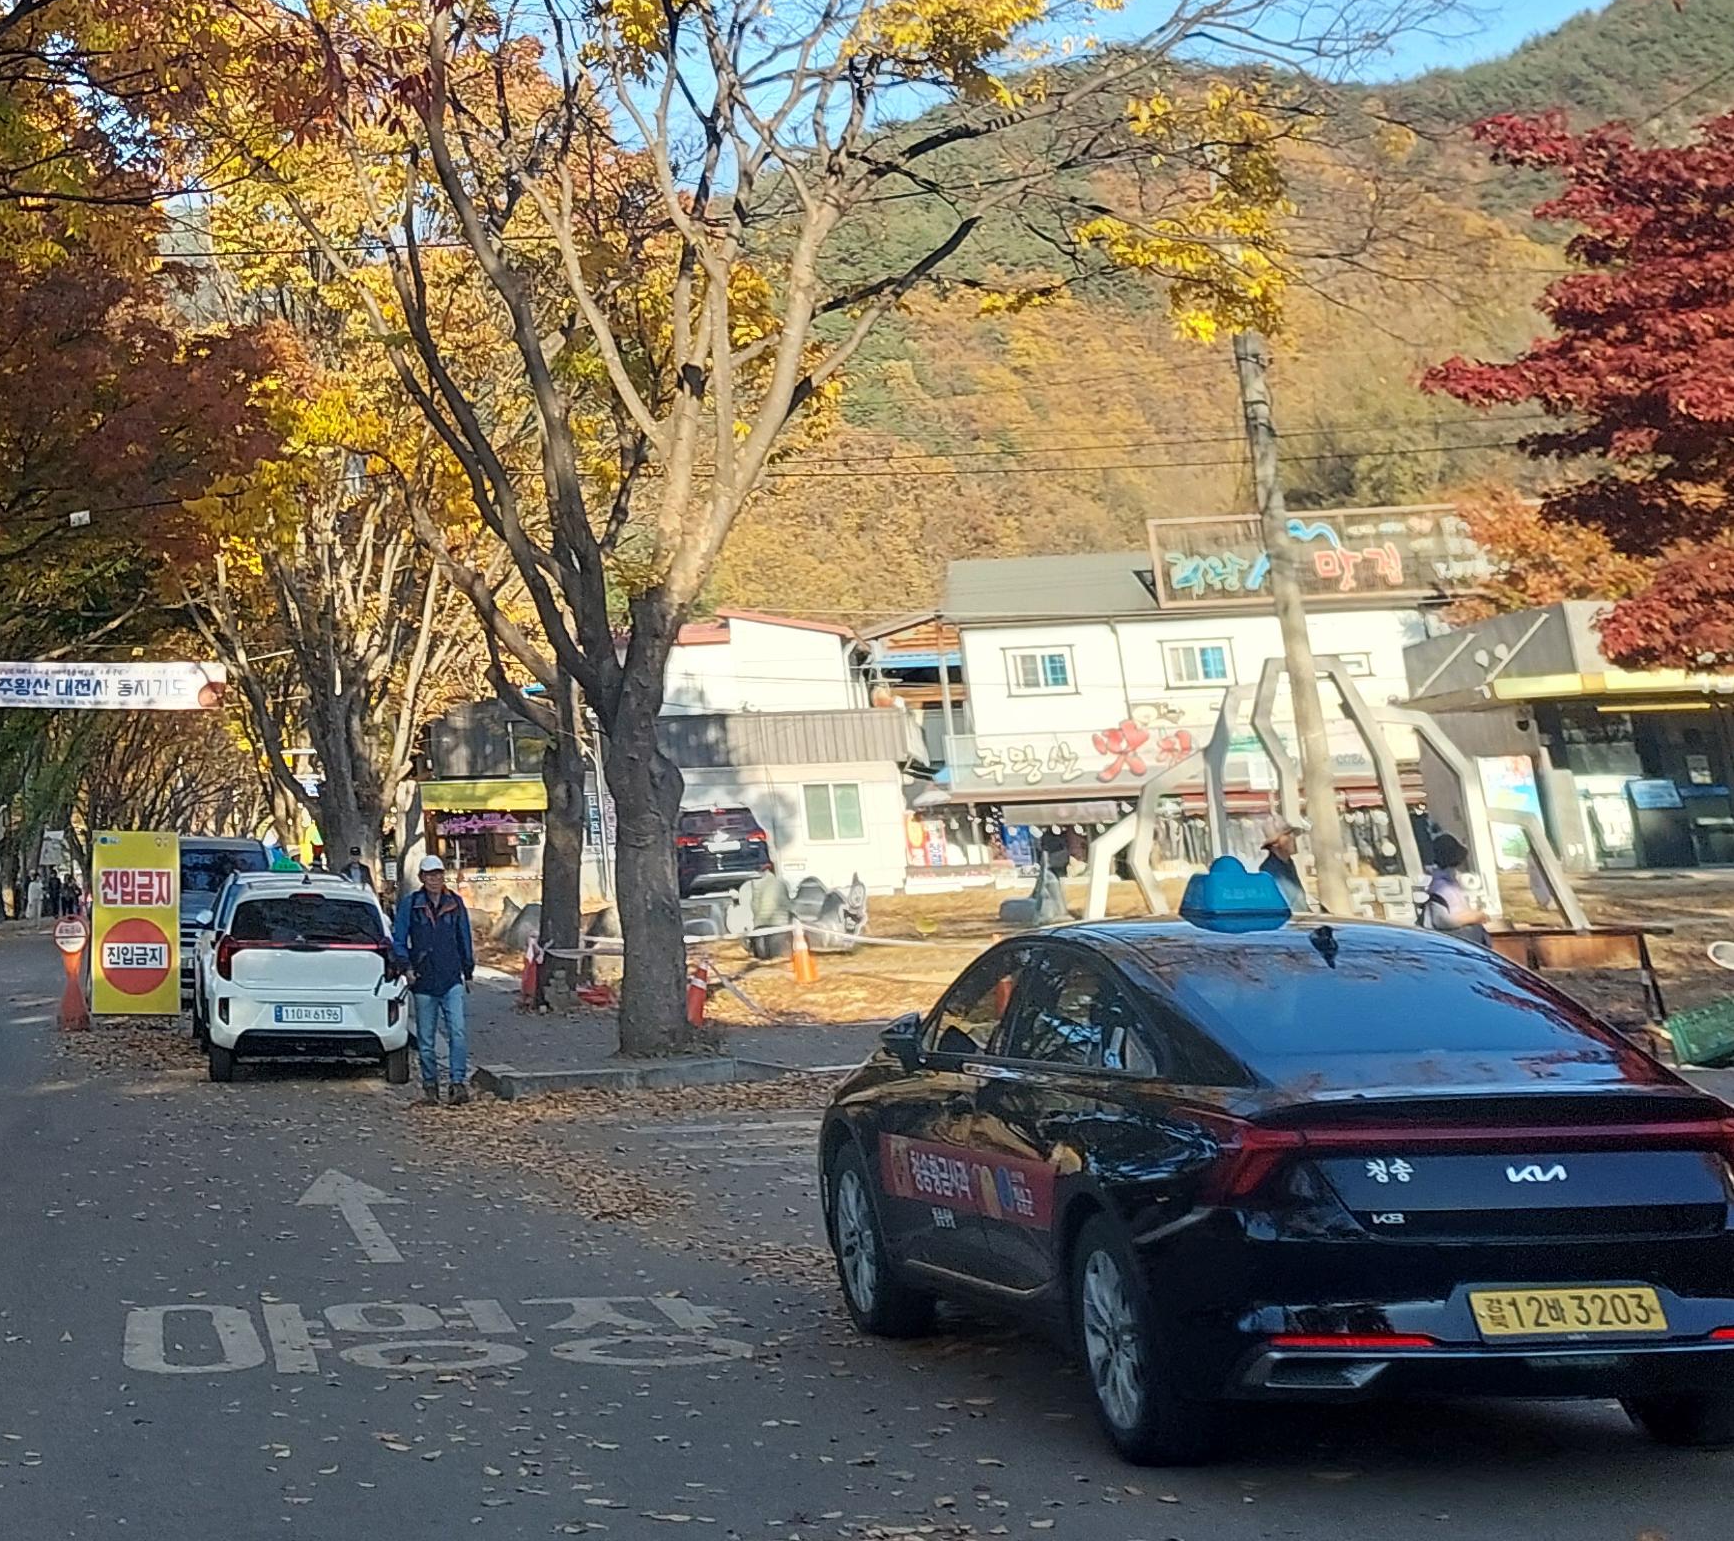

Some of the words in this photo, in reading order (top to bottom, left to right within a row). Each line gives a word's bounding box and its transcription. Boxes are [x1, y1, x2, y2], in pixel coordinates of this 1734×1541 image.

[56, 677, 108, 697] 대전사
[117, 678, 189, 697] 동지기도
[101, 869, 172, 906] 진입금지
[107, 946, 164, 966] 진입금지
[313, 1008, 340, 1021] 6196
[1366, 1158, 1415, 1184] 청송
[1371, 1212, 1406, 1225] K8
[1509, 1295, 1567, 1330] 12바
[1568, 1293, 1652, 1326] 3203
